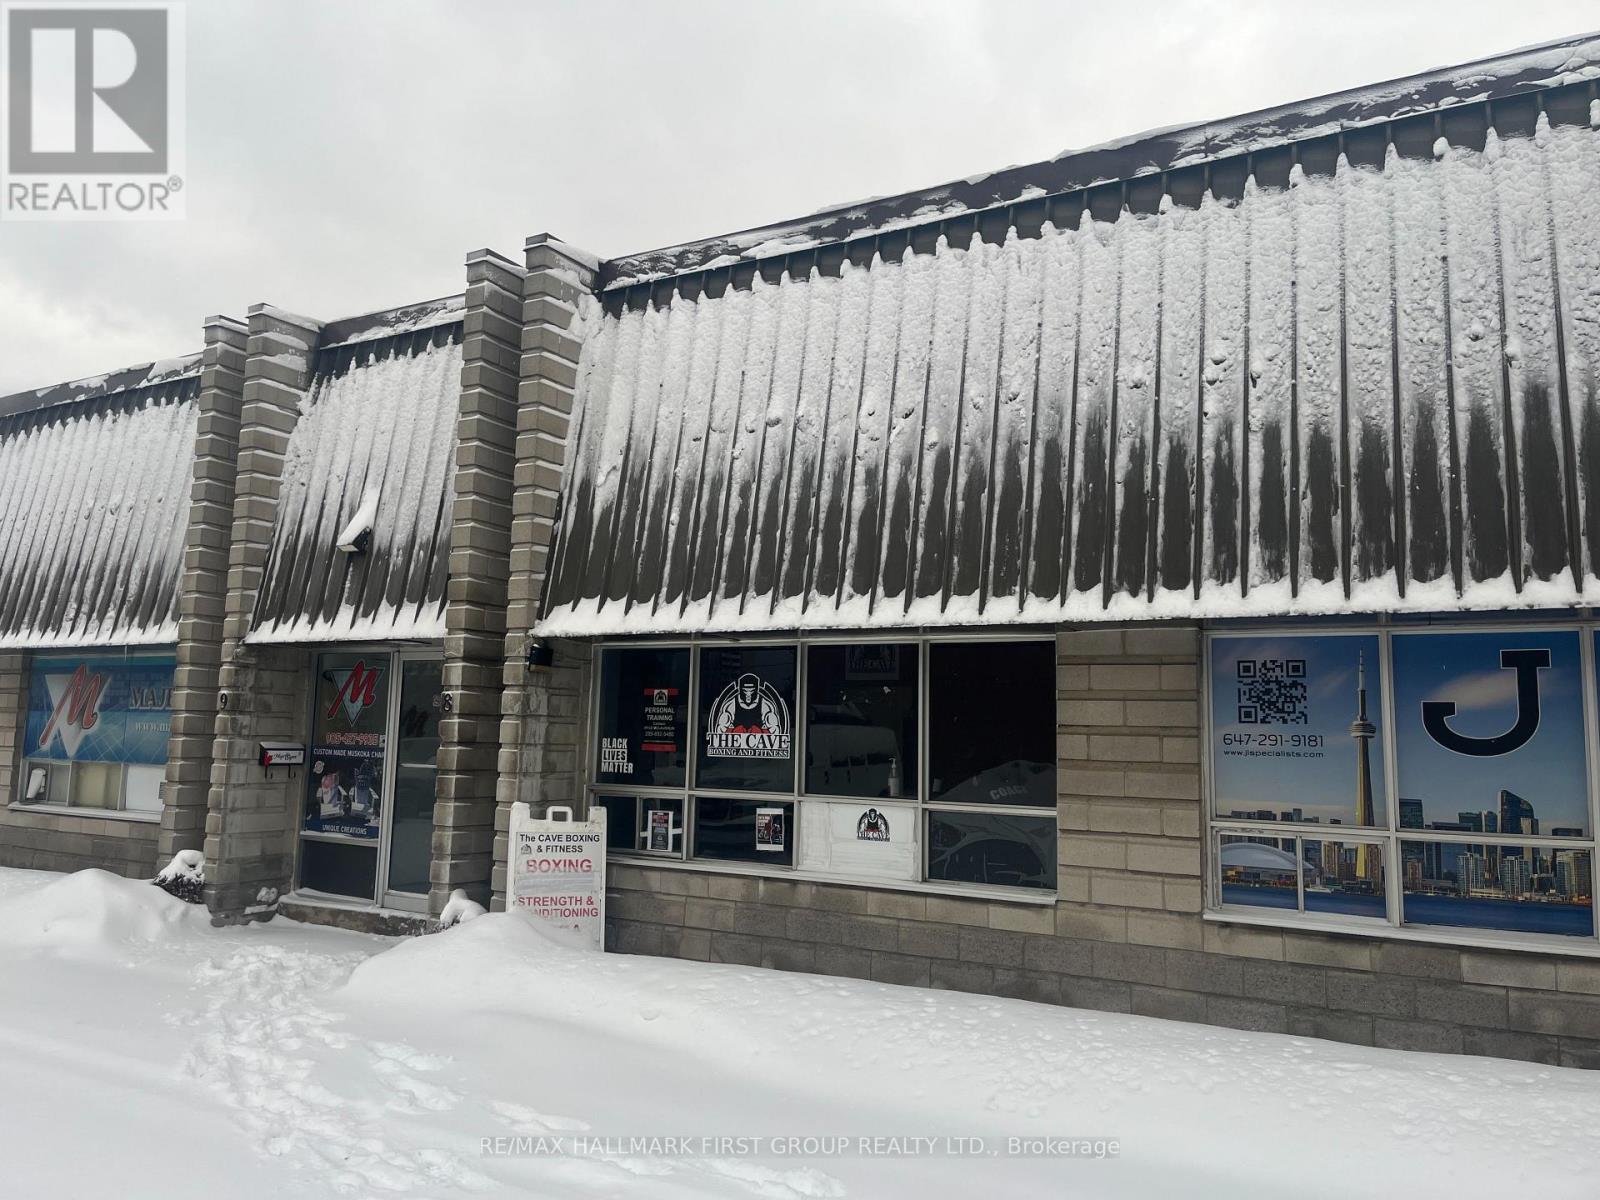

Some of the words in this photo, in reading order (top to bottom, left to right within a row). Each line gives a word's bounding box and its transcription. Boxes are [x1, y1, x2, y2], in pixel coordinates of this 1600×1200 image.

[220, 693, 228, 710] 9
[444, 693, 453, 712] 8
[1421, 648, 1552, 758] J
[602, 737, 628, 749] BLACK
[707, 733, 741, 748] THE
[745, 733, 790, 749] CAVE
[1223, 733, 1324, 748] 647-291-9181
[313, 748, 333, 756] CUSTOM
[333, 748, 347, 756] MADE
[347, 749, 371, 757] MUSKOKA
[602, 748, 628, 762] LIVES
[709, 748, 736, 756] BOXING
[601, 762, 634, 774] MATTER
[322, 824, 340, 833] UNIQUE
[340, 826, 368, 835] CREATIONS
[520, 834, 536, 843] The
[538, 834, 564, 843] CAVE
[565, 834, 600, 843] BOXING
[536, 845, 543, 854] &
[545, 845, 584, 854] FITNESS
[526, 859, 592, 873] BOXING
[518, 895, 583, 906] STRENGTH
[586, 895, 595, 906] &
